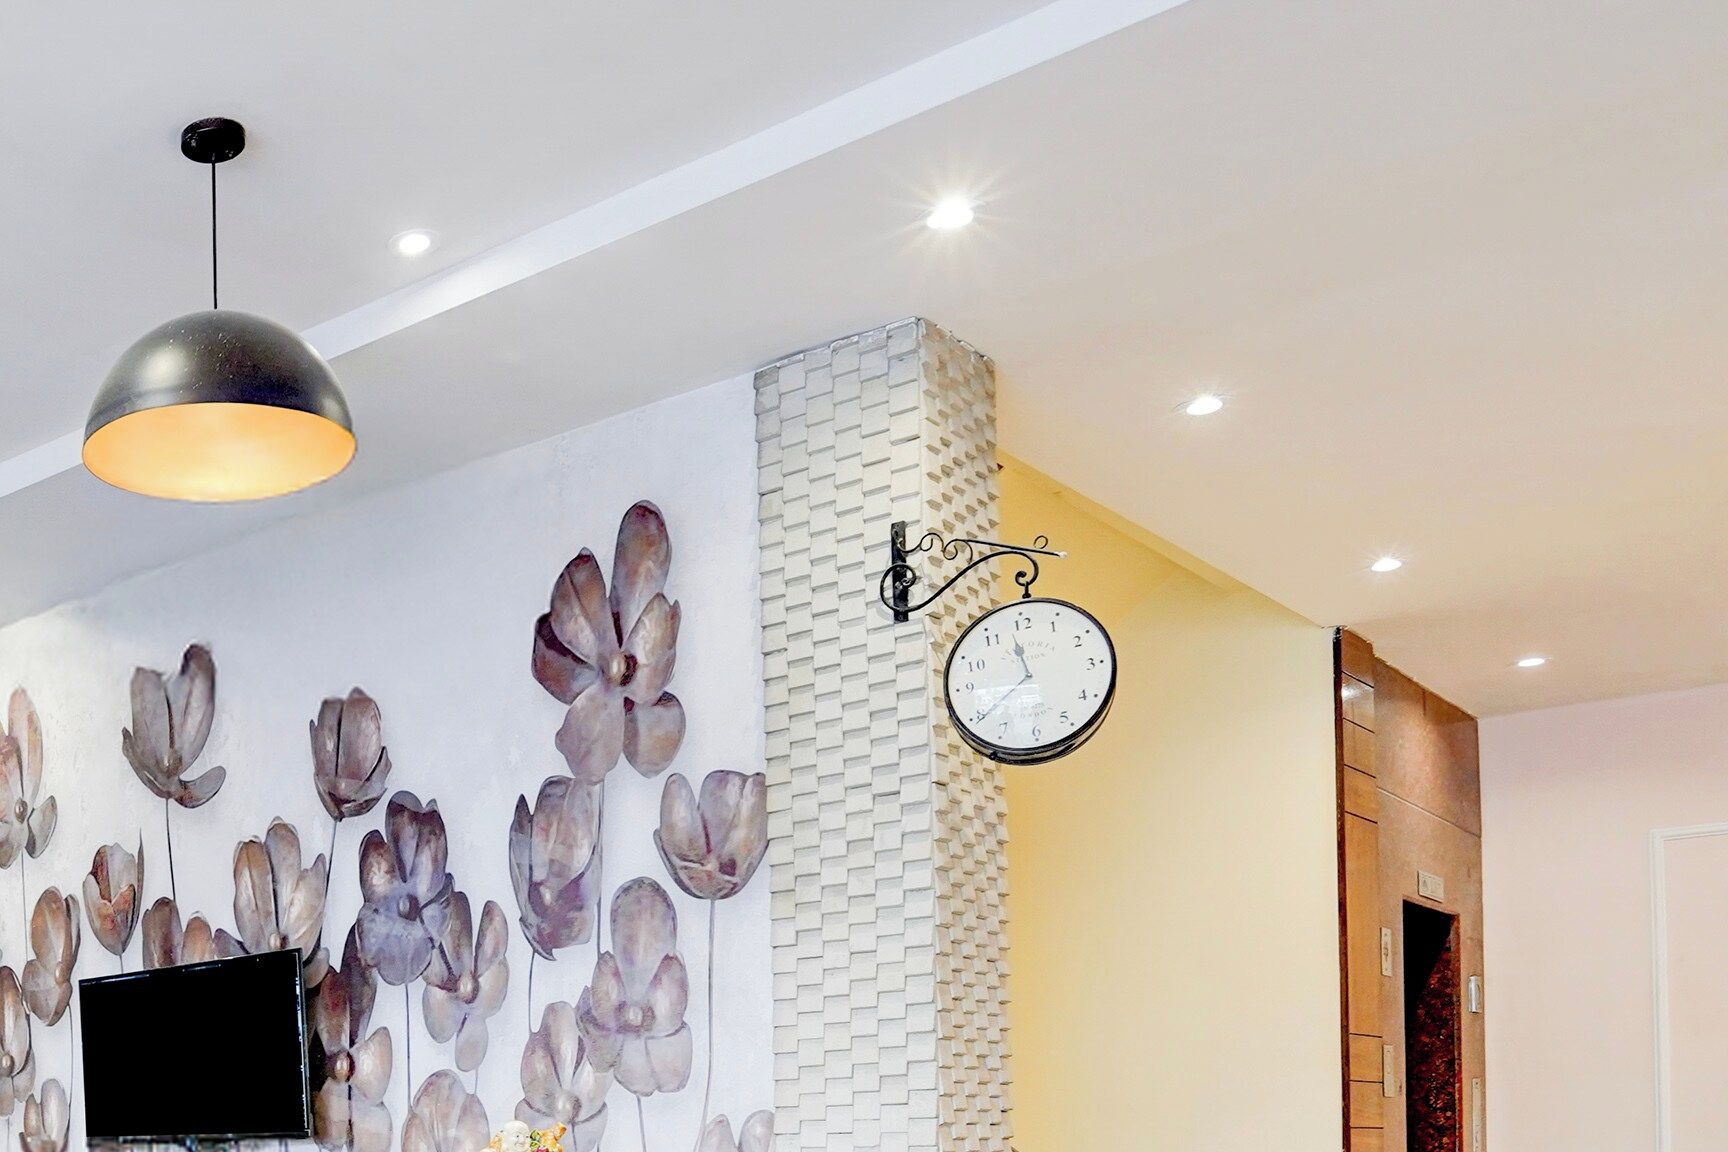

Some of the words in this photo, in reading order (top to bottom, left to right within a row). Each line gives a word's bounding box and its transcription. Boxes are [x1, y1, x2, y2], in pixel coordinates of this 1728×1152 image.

[1014, 617, 1032, 631] 12
[1050, 620, 1056, 633] 1
[985, 633, 1001, 647] 11
[1073, 635, 1083, 648] 2
[968, 659, 985, 672] 10
[1086, 657, 1096, 671] 3
[966, 682, 974, 694] 9
[1078, 689, 1087, 701] 4
[1060, 711, 1069, 723] 5
[999, 722, 1008, 735] 7
[1032, 724, 1041, 737] 6
